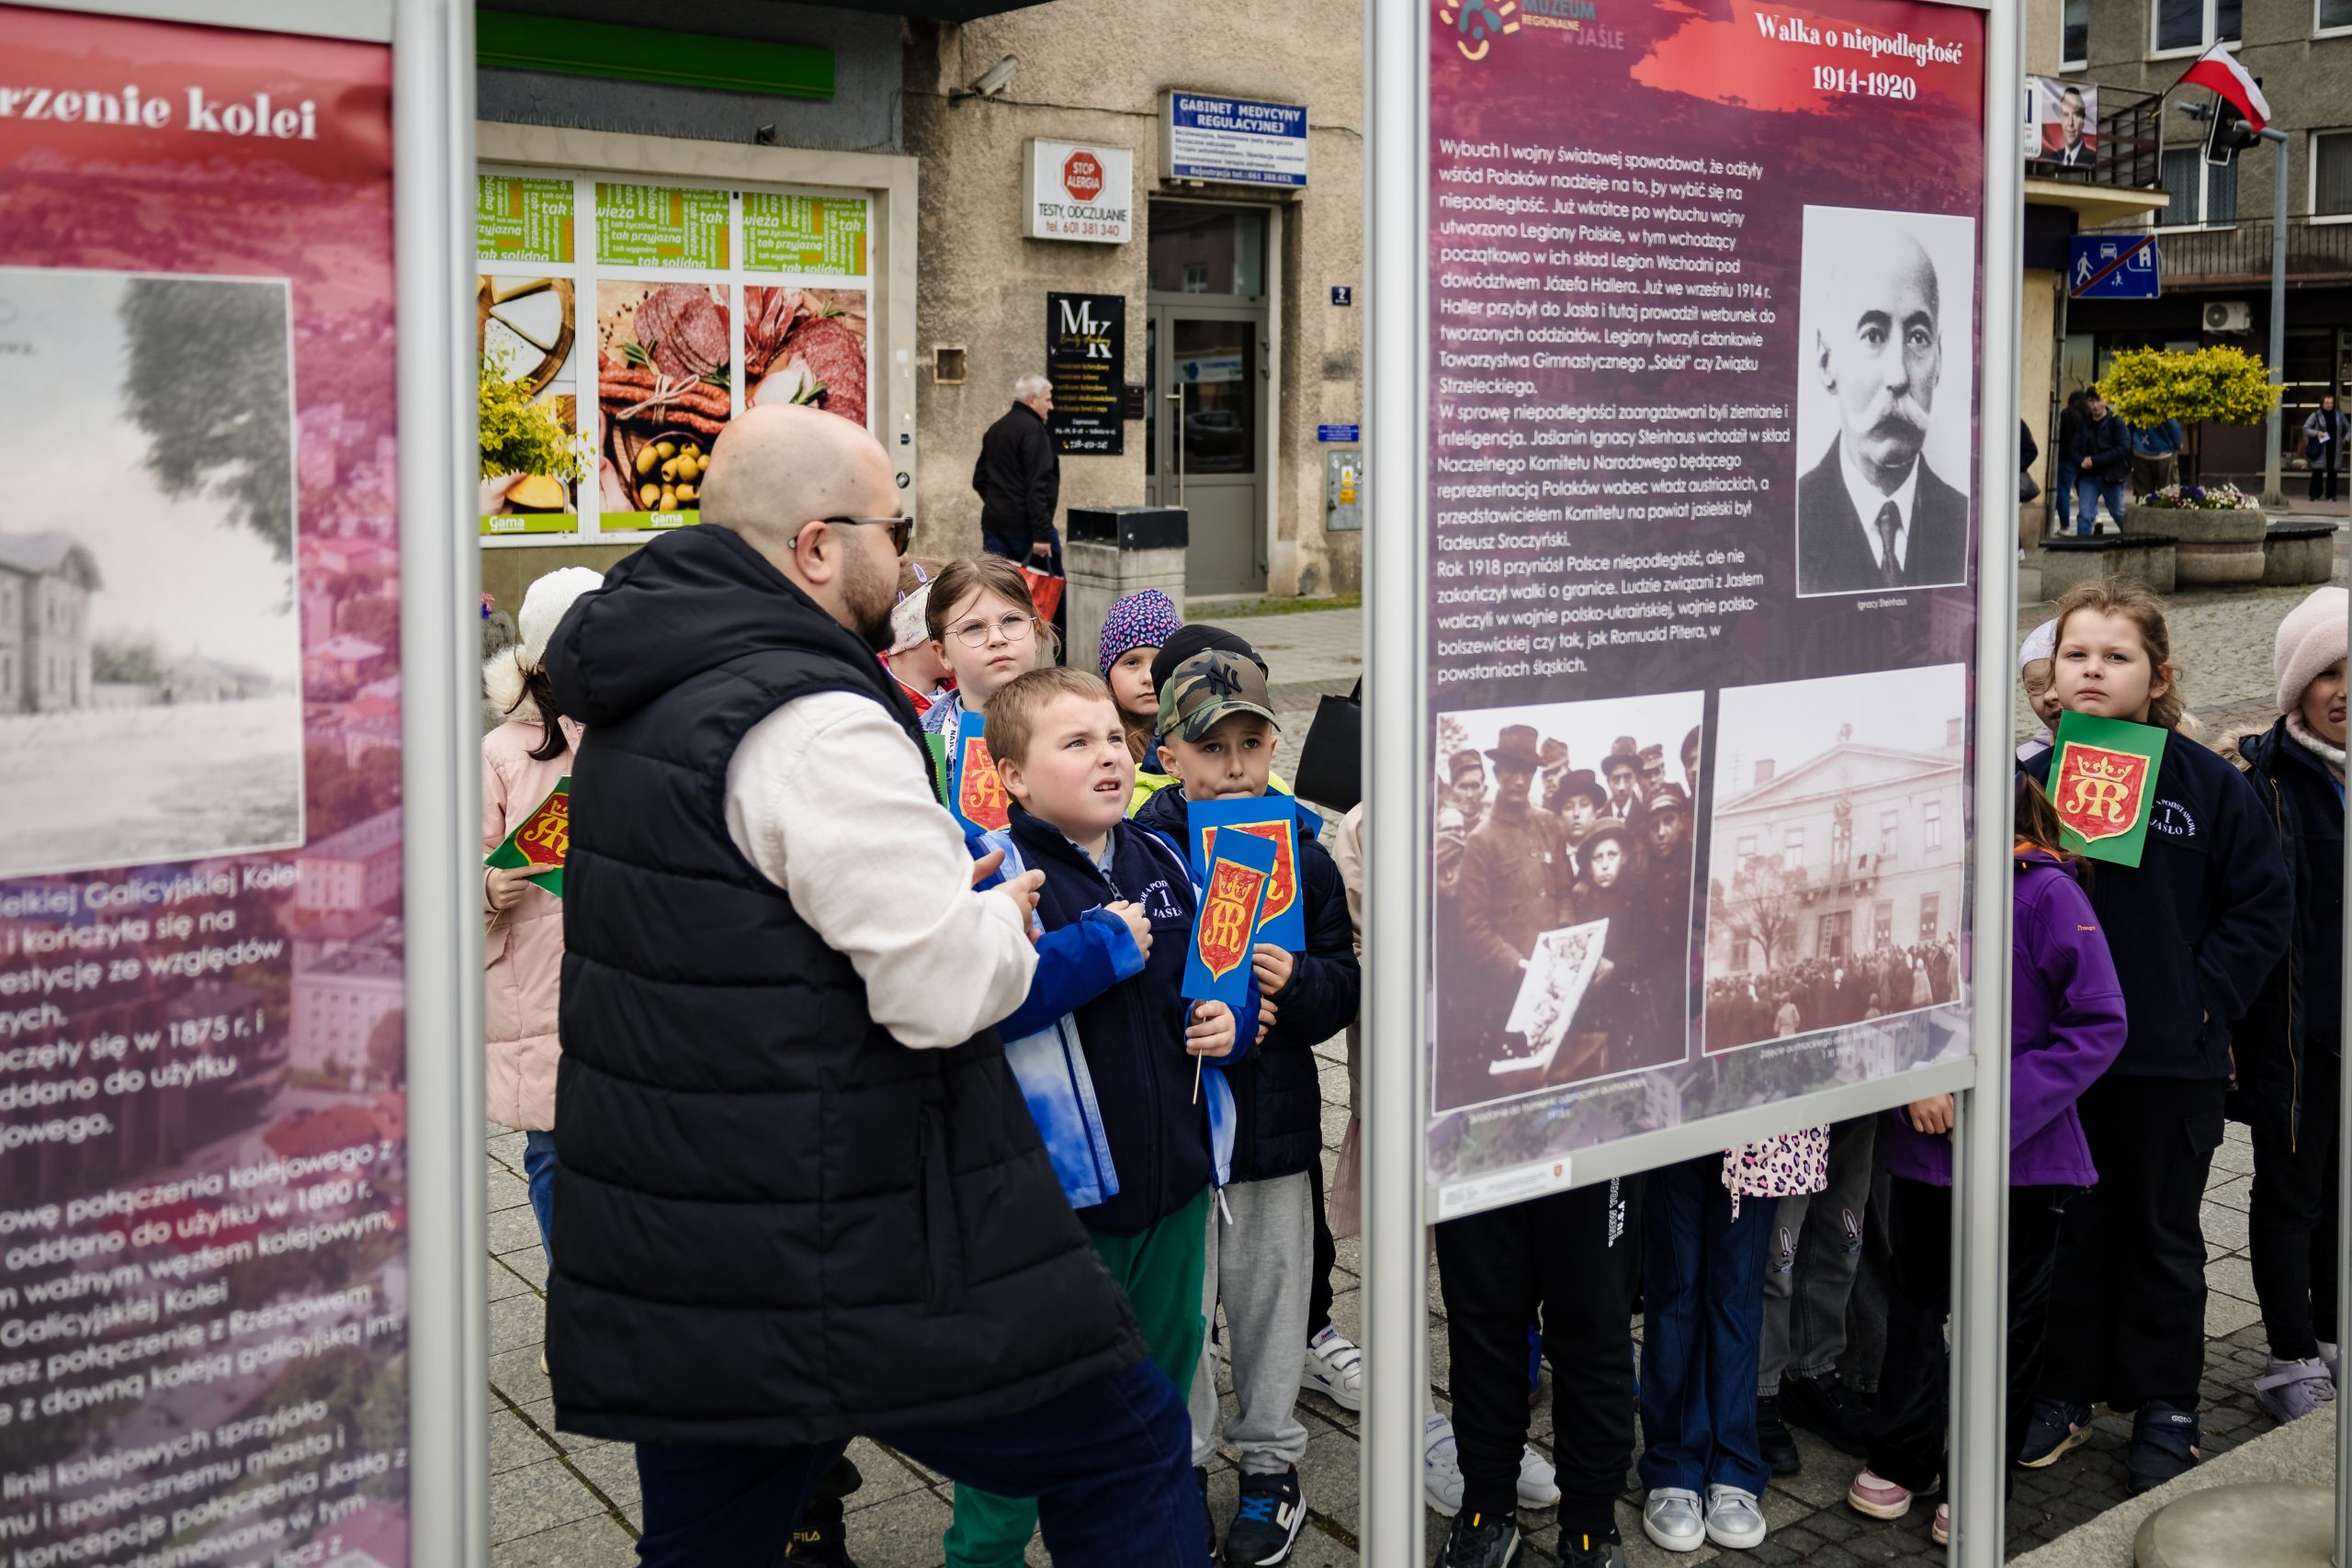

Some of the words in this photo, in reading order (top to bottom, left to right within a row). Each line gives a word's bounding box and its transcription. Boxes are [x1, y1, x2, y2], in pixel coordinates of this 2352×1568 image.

[1521, 14, 1580, 31] REGIONALNE
[1576, 24, 1624, 50] JAŚLE
[1753, 12, 1821, 45] Walka
[1825, 29, 1838, 47] o
[1842, 28, 1963, 67] niepodległość
[1812, 65, 1917, 101] 1914-1920
[187, 86, 318, 140] kolei
[1180, 98, 1233, 115] GABINET
[1238, 105, 1301, 122] MEDYCYNY
[1197, 114, 1284, 133] REGULACYJNEJ
[1072, 162, 1095, 175] STOP
[1441, 139, 1500, 163] Wybuch
[1504, 143, 1508, 160] I
[1511, 145, 1555, 169] wojny
[1558, 147, 1622, 173] światowej
[1625, 152, 1707, 175] spowodował,
[1710, 157, 1724, 174] że
[1726, 157, 1763, 182] odżyły
[1067, 175, 1101, 189] ALERGIA
[1439, 166, 1483, 185] wśród
[1487, 168, 1547, 189] Polaków
[1551, 173, 1609, 197] nadzieje
[1611, 181, 1629, 194] na
[1652, 178, 1667, 202] by
[1669, 180, 1705, 203] wybić
[1709, 183, 1724, 203] się
[1726, 188, 1742, 201] na
[542, 201, 567, 215] tak
[700, 210, 723, 224] tak
[1038, 203, 1065, 220] TESTY,
[1068, 205, 1127, 222] ODCZULANIE
[1440, 193, 1548, 218] niepodległość.
[1553, 197, 1575, 216] Już
[1577, 199, 1629, 219] wkrótce
[1633, 207, 1650, 224] po
[1653, 203, 1708, 226] wybuchu
[1711, 207, 1744, 230] wojny
[840, 219, 861, 231] tak
[1046, 220, 1060, 232] tel.
[1063, 221, 1080, 233] 601
[1082, 222, 1099, 235] 381
[1101, 224, 1119, 237] 340
[611, 231, 629, 241] tak
[631, 231, 682, 244] przyjazna
[1441, 220, 1518, 239] utworzono
[1521, 221, 1576, 246] Legiony
[1579, 224, 1624, 246] Polskie,
[1628, 231, 1640, 243] w
[1643, 228, 1666, 250] tym
[1668, 229, 1736, 254] wchodzący
[501, 250, 549, 263] solidna
[639, 256, 659, 266] tak
[662, 257, 707, 269] solidna
[1441, 247, 1531, 268] początkowo
[1533, 254, 1546, 265] w
[1550, 249, 1570, 266] ich
[1574, 250, 1608, 268] skład
[1611, 251, 1654, 275] Legion
[1657, 253, 1713, 272] Wschodni
[1716, 255, 1740, 277] pod
[1339, 288, 1346, 299] 2
[1441, 270, 1540, 290] dowództwem
[1544, 274, 1588, 292] Józefa
[1591, 276, 1640, 294] Hallera.
[1643, 276, 1662, 295] Już
[1665, 283, 1683, 296] we
[1686, 280, 1733, 297] wrześniu
[1737, 280, 1762, 299] 1914
[1442, 351, 1530, 374] Towarzystwa
[1532, 352, 1645, 376] Gimnastycznego
[1648, 353, 1691, 373] „Sokół”
[1694, 358, 1713, 376] czy
[1715, 354, 1758, 374] Związku
[1440, 377, 1537, 400] Strzeleckiego.
[1438, 454, 1526, 476] Naczelnego
[1530, 453, 1590, 470] Komitetu
[1594, 452, 1678, 475] Narodowego
[1680, 451, 1741, 474] będącego
[650, 512, 684, 527] Gama
[1439, 532, 1495, 549] Tadeusz
[1498, 530, 1570, 554] Sroczyński.
[1437, 558, 1464, 577] Rok
[1470, 557, 1501, 575] 1918
[1504, 555, 1564, 580] przyniósł
[1567, 554, 1611, 571] Polsce
[1613, 550, 1703, 575] niepodległość,
[1706, 548, 1724, 567] ale
[1727, 548, 1745, 566] nie
[1438, 660, 1530, 686] powstaniach
[1533, 657, 1587, 679] śląskich.
[2165, 808, 2171, 824] 1
[1159, 889, 1170, 907] 1
[200, 912, 235, 933] na
[105, 1068, 144, 1095] do
[793, 1530, 821, 1542] FILA
